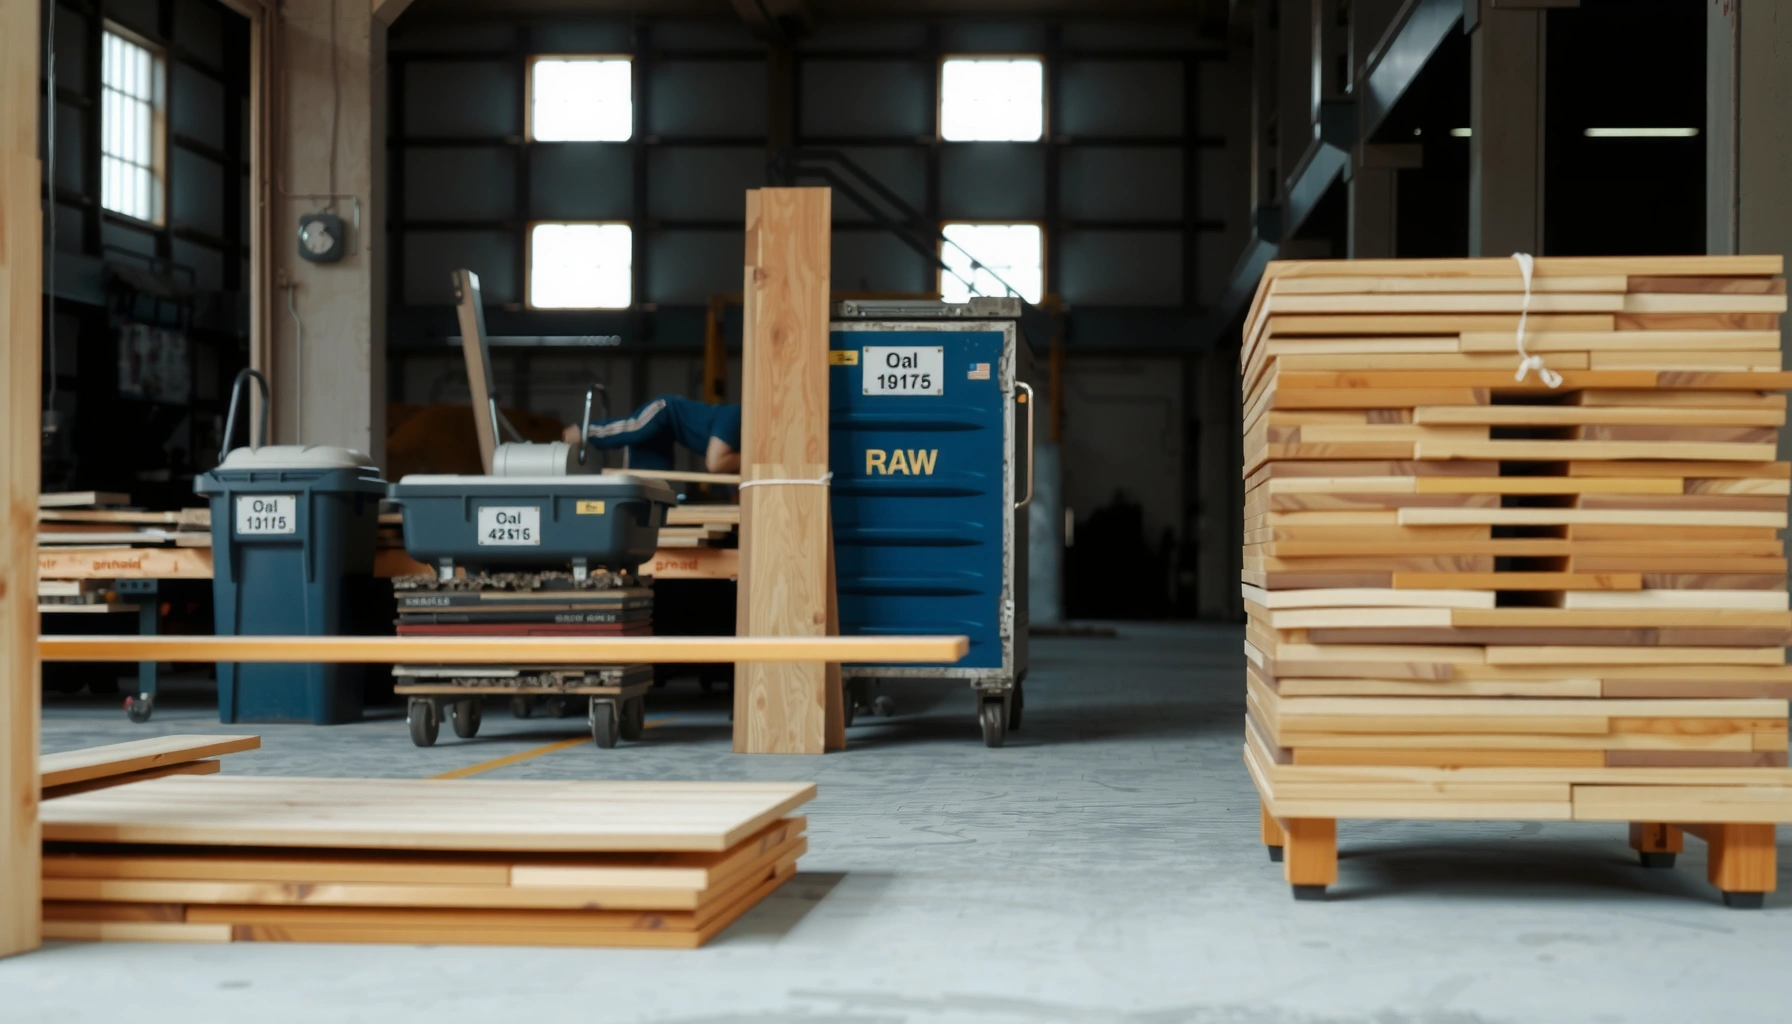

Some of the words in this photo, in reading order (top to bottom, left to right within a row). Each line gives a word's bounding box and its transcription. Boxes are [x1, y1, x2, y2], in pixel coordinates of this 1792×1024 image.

[886, 352, 918, 369] Oal
[877, 374, 931, 390] 19175
[866, 449, 939, 476] RAW
